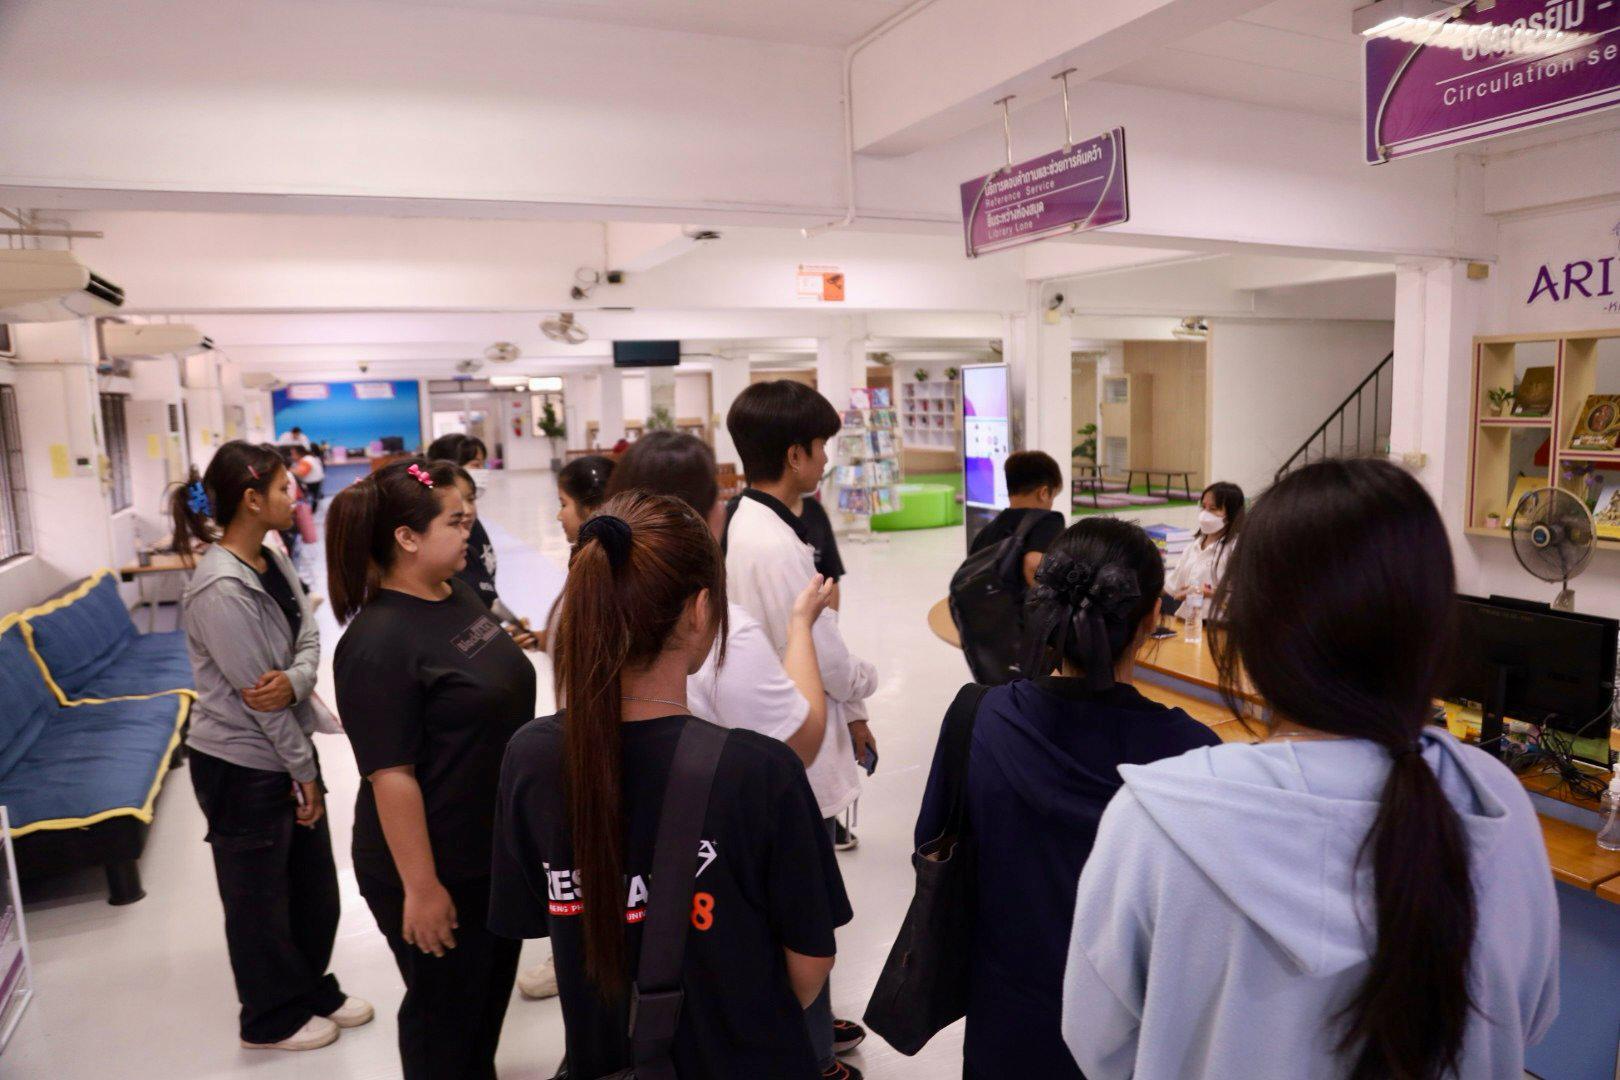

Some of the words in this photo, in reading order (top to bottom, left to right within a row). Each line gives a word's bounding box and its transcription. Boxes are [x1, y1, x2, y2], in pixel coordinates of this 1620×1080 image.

[1443, 57, 1574, 106] Circulation
[1587, 44, 1617, 65] se
[985, 191, 1021, 208] Reference
[1026, 179, 1055, 196] Service
[987, 226, 1013, 240] Library
[691, 891, 715, 931] 8
